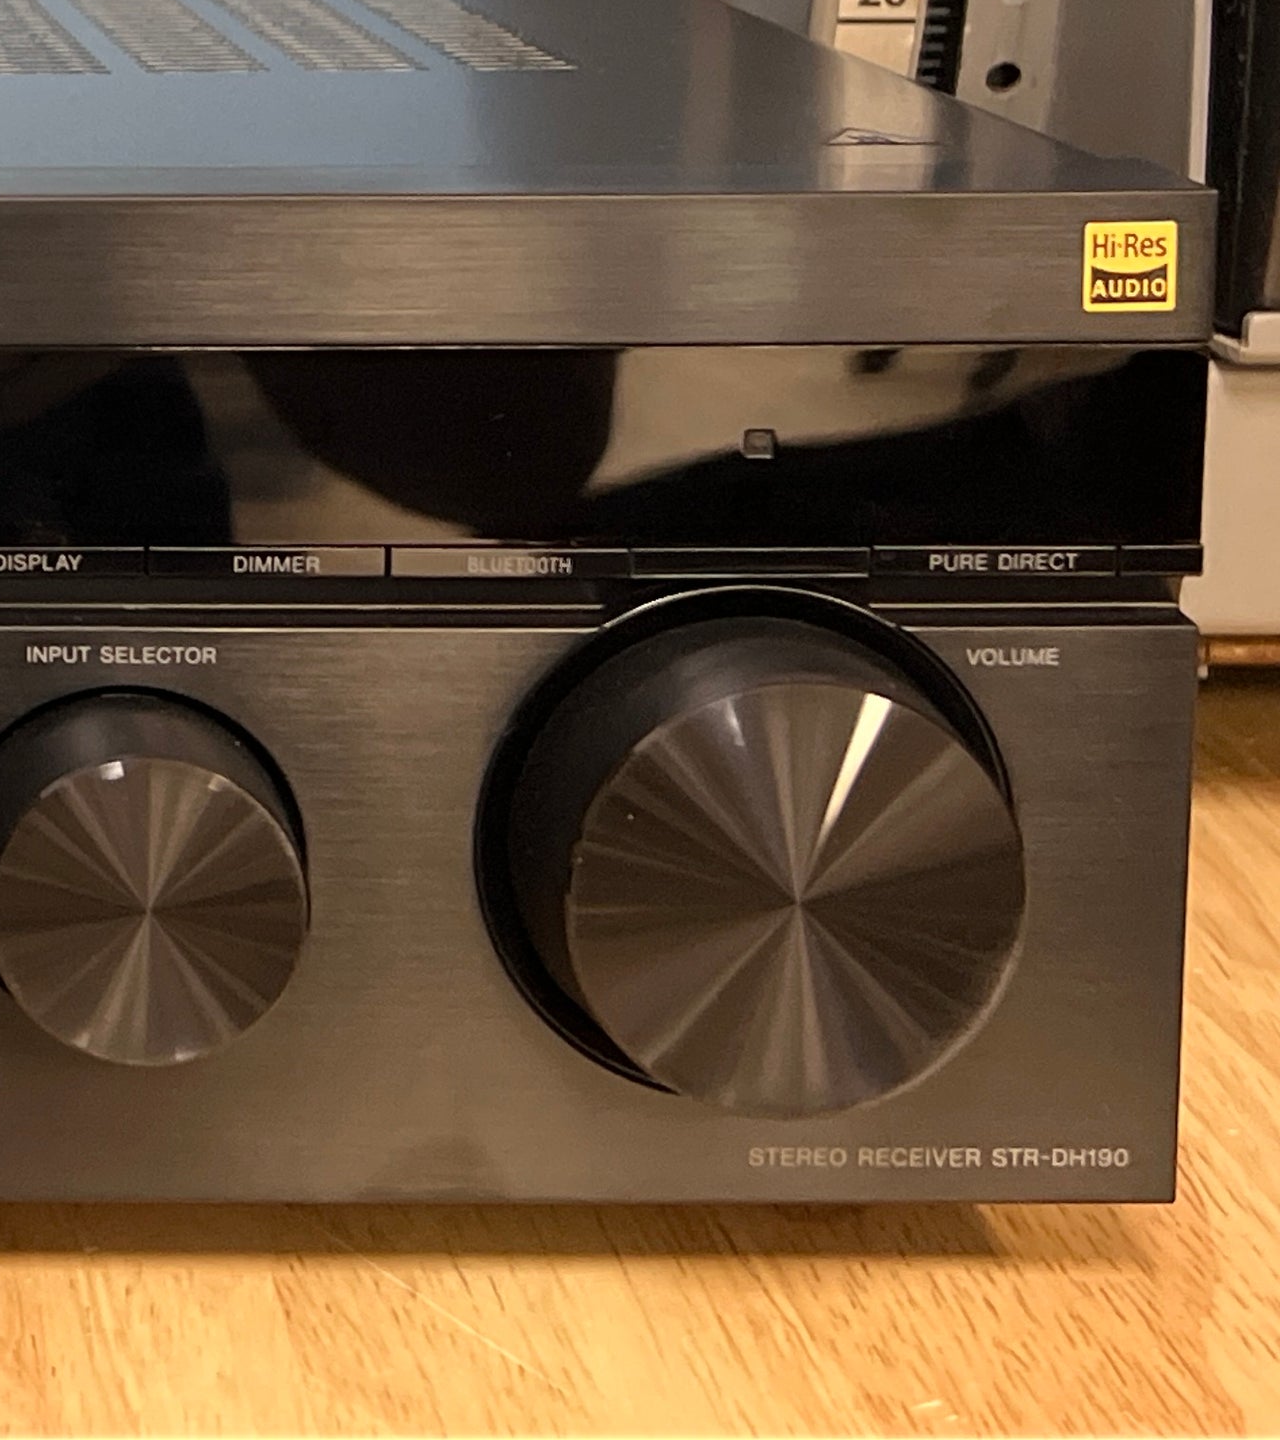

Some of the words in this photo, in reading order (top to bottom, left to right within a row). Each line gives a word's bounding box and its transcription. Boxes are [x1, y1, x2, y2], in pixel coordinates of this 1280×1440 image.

[1091, 277, 1166, 298] AUDIO
[233, 555, 321, 574] DIMMER
[467, 556, 573, 575] BLUETOOTH
[928, 553, 987, 571] PURE
[998, 553, 1078, 571] DIRECT
[26, 646, 91, 663] INPUT
[100, 646, 217, 665] SELECTOR
[966, 647, 1059, 667] VOLUME
[747, 1147, 847, 1168] STEREO
[858, 1147, 981, 1168] RECEIVER
[991, 1147, 1129, 1168] STR-DH190
